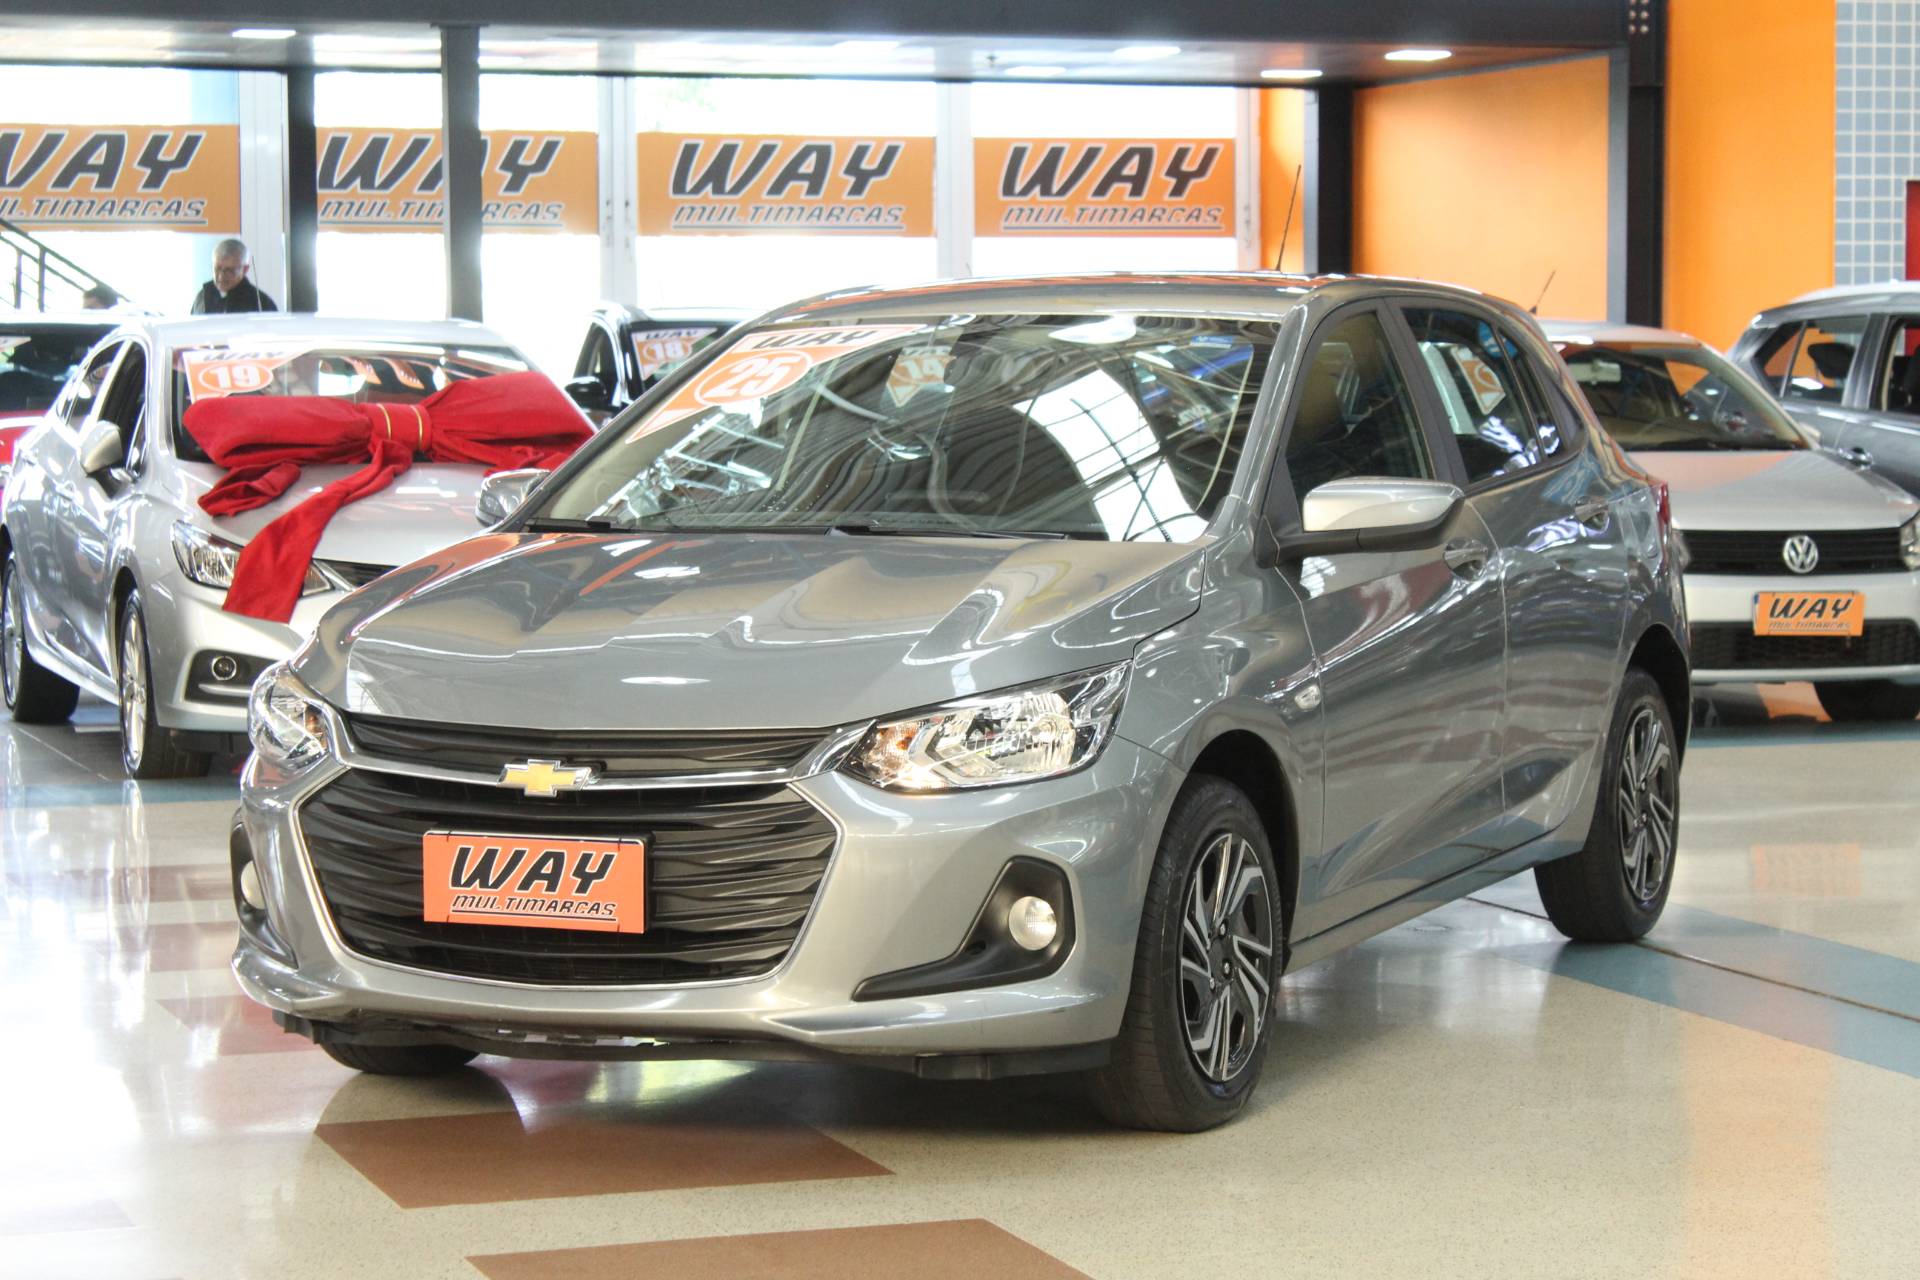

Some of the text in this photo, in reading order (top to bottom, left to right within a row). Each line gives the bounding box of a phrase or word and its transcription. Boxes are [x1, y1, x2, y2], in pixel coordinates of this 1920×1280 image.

[670, 139, 905, 199] WAY
[999, 142, 1224, 201] WAY
[0, 198, 207, 218] LTIMARCAS
[319, 200, 565, 222] MULTIRCAS
[673, 204, 905, 224] MULTIMARCAS
[1003, 206, 1224, 225] MULTIMARCAS
[751, 329, 882, 350] WAY
[208, 364, 262, 389] 19
[702, 355, 802, 398] 25
[1768, 597, 1853, 619] WAY
[449, 845, 617, 896] WAY
[452, 895, 617, 916] MULTIMARCAS
